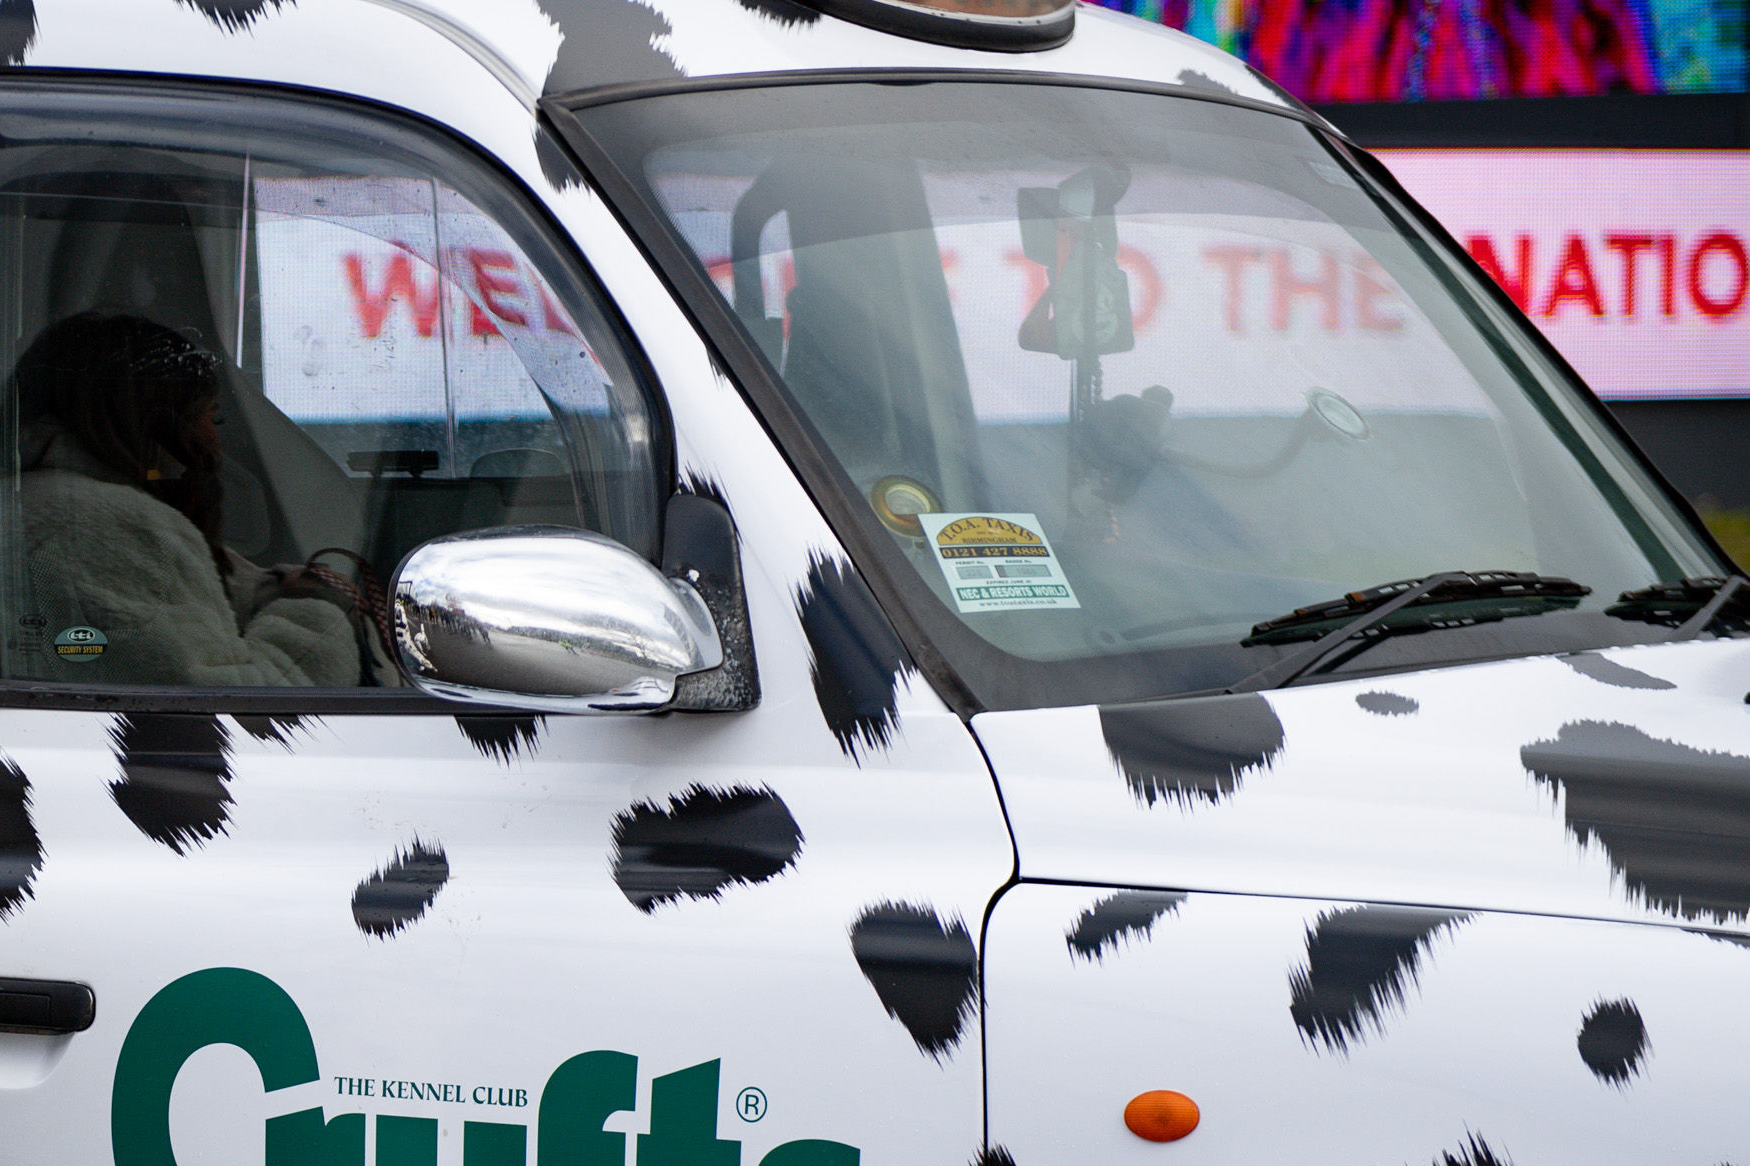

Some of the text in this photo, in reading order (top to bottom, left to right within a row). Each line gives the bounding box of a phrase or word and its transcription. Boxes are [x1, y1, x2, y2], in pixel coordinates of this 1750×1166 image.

[1202, 246, 1408, 334] THE
[940, 517, 1034, 542] T.O.A. TAXIS
[942, 545, 1048, 558] 0121 427 8888
[960, 586, 1067, 600] NEC & RESORTS WORLD
[57, 645, 103, 654] SECURITY SYSTEM
[334, 1075, 529, 1109] THE KENNEL CLUB
